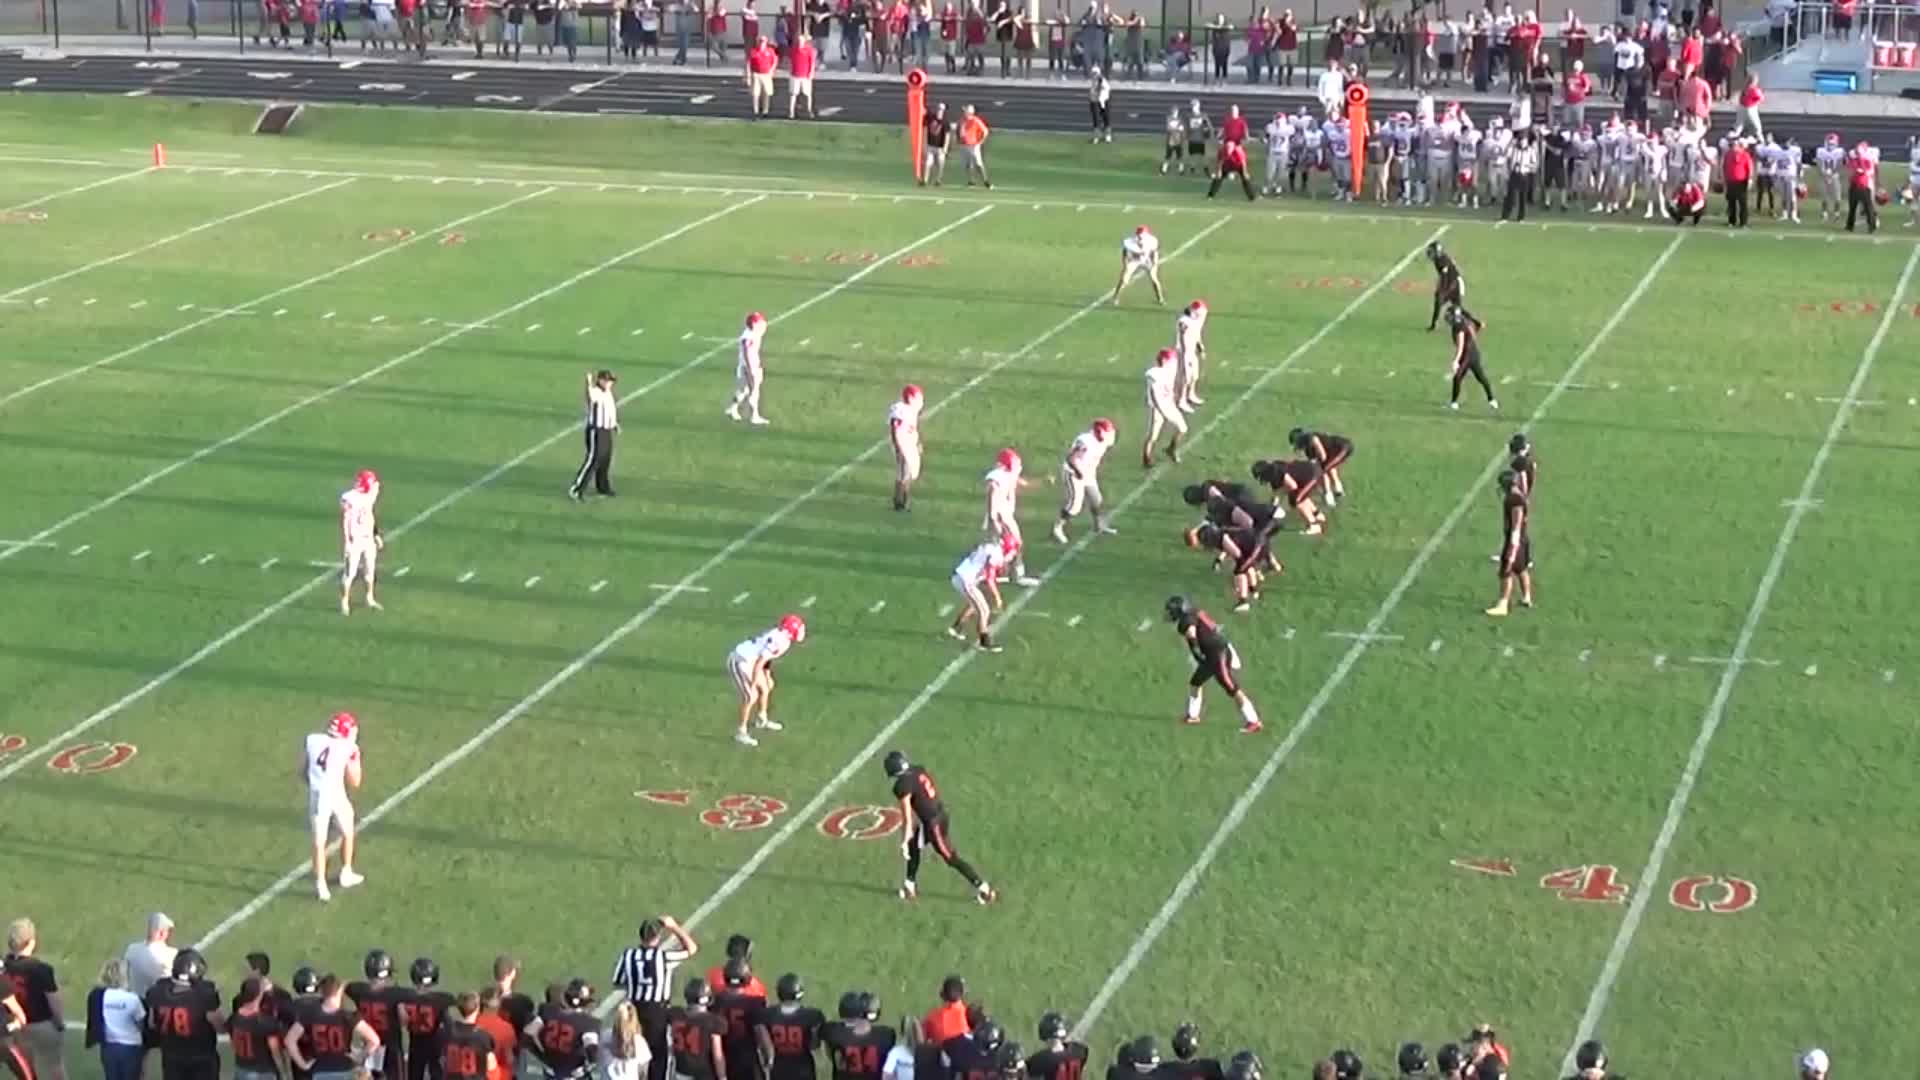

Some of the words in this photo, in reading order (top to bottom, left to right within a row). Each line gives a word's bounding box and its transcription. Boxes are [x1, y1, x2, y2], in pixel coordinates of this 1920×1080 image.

[316, 747, 330, 771] 4
[636, 960, 653, 985] L
[159, 1007, 192, 1036] 78
[312, 1023, 345, 1052] 50
